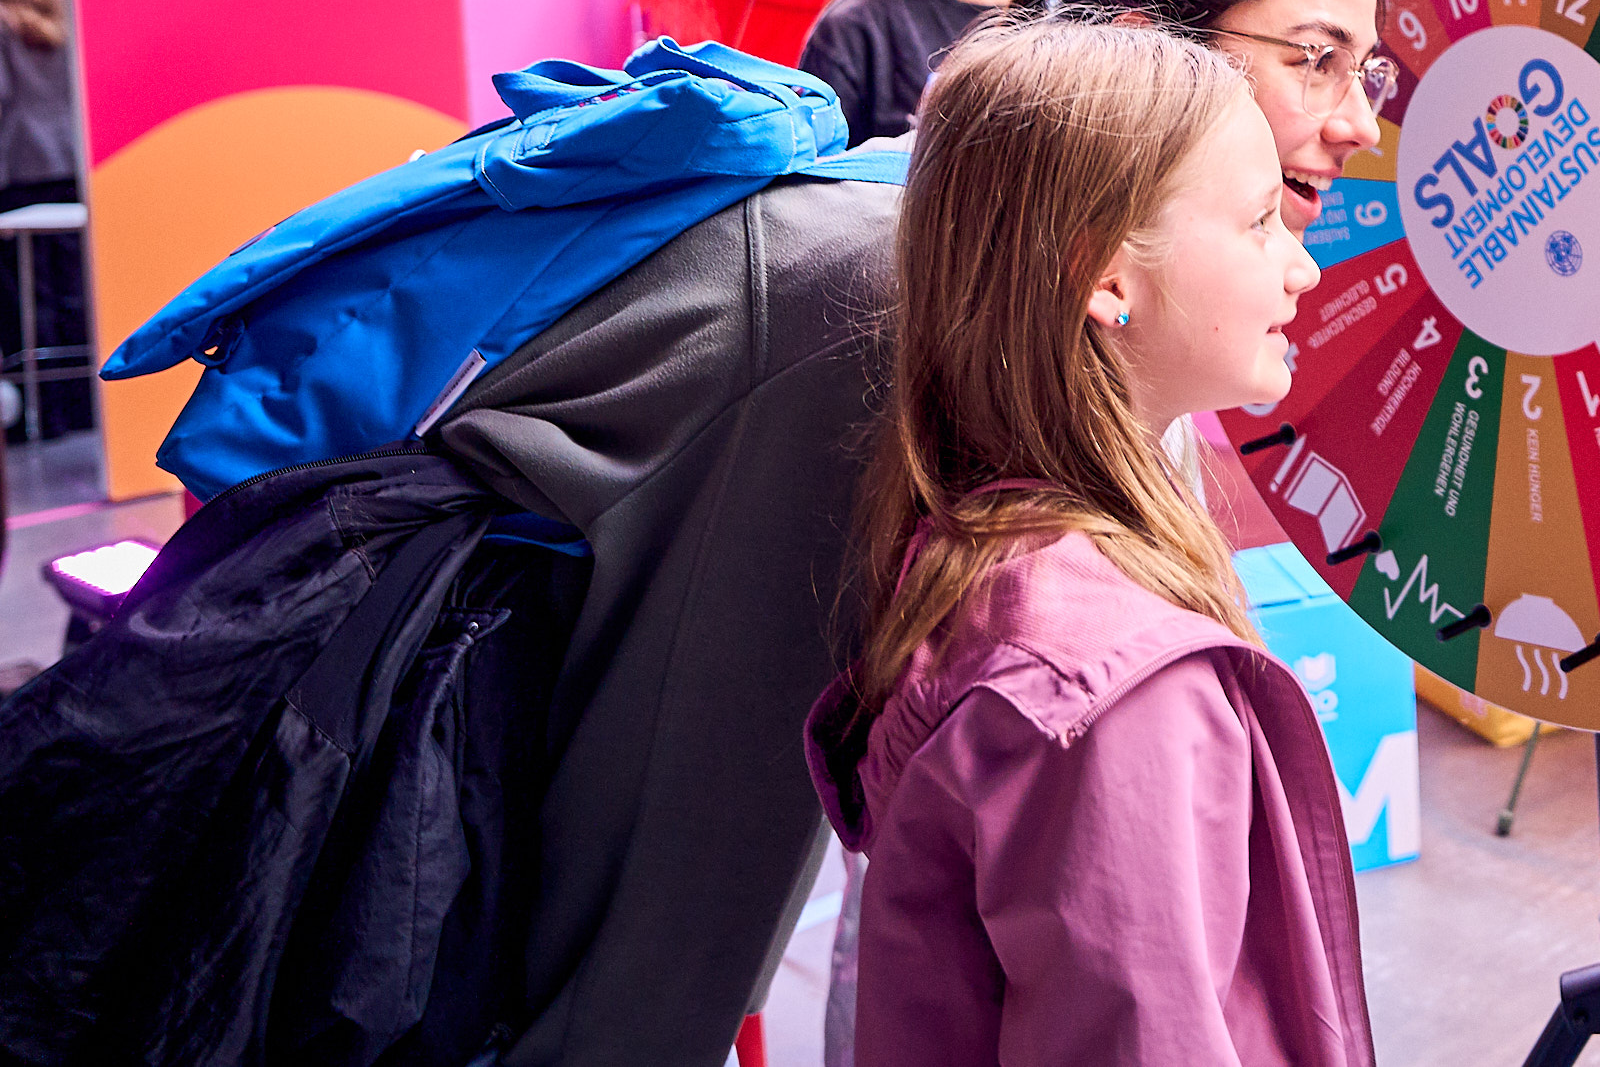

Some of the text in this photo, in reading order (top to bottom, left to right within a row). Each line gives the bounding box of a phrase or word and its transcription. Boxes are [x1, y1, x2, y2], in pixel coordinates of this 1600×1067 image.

[1399, 8, 1427, 52] 9
[1444, 97, 1590, 260] DEVELOPMENT
[1354, 200, 1388, 227] 6
[1374, 262, 1409, 296] 5
[1413, 315, 1442, 351] 4
[1376, 347, 1411, 397] BILDUNG
[1465, 355, 1488, 399] 3
[1576, 371, 1600, 418] 1
[1370, 360, 1422, 436] HOCHWERTIGE
[1520, 374, 1542, 420] 2
[1434, 401, 1467, 497] WOHLERGEHEN
[1444, 409, 1479, 517] GESUNDHEIT UND
[1526, 428, 1543, 523] KEIN HUNGER
